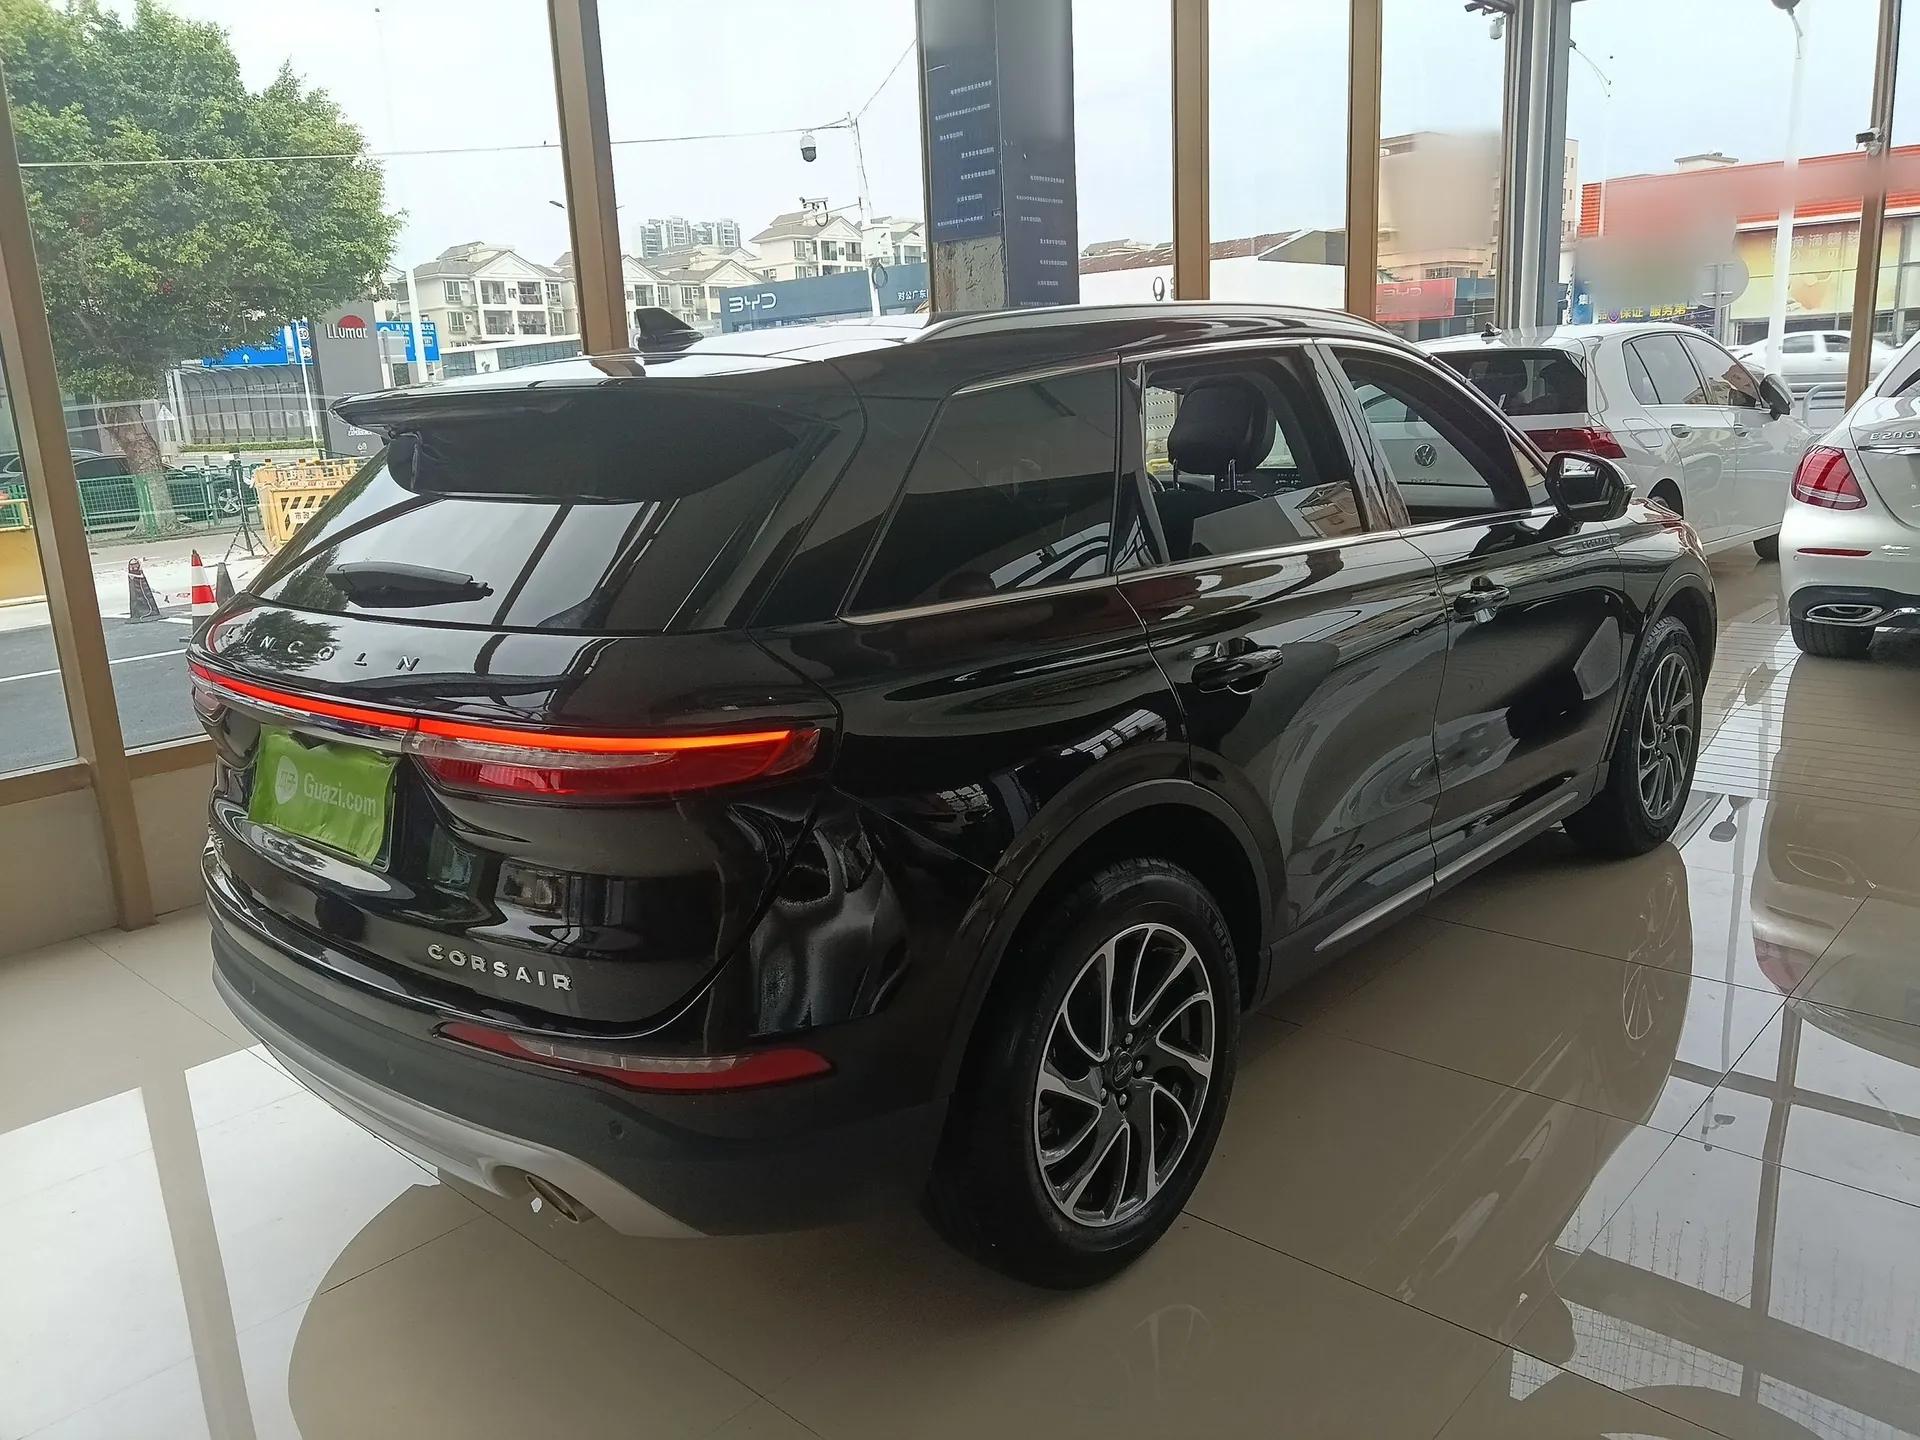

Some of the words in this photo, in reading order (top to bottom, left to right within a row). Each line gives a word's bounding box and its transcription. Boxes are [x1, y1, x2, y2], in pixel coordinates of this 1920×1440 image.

[729, 293, 776, 312] BYD
[226, 627, 420, 671] LINCOLN
[303, 772, 377, 818] Guazi.com
[427, 944, 573, 991] CORSAIR
